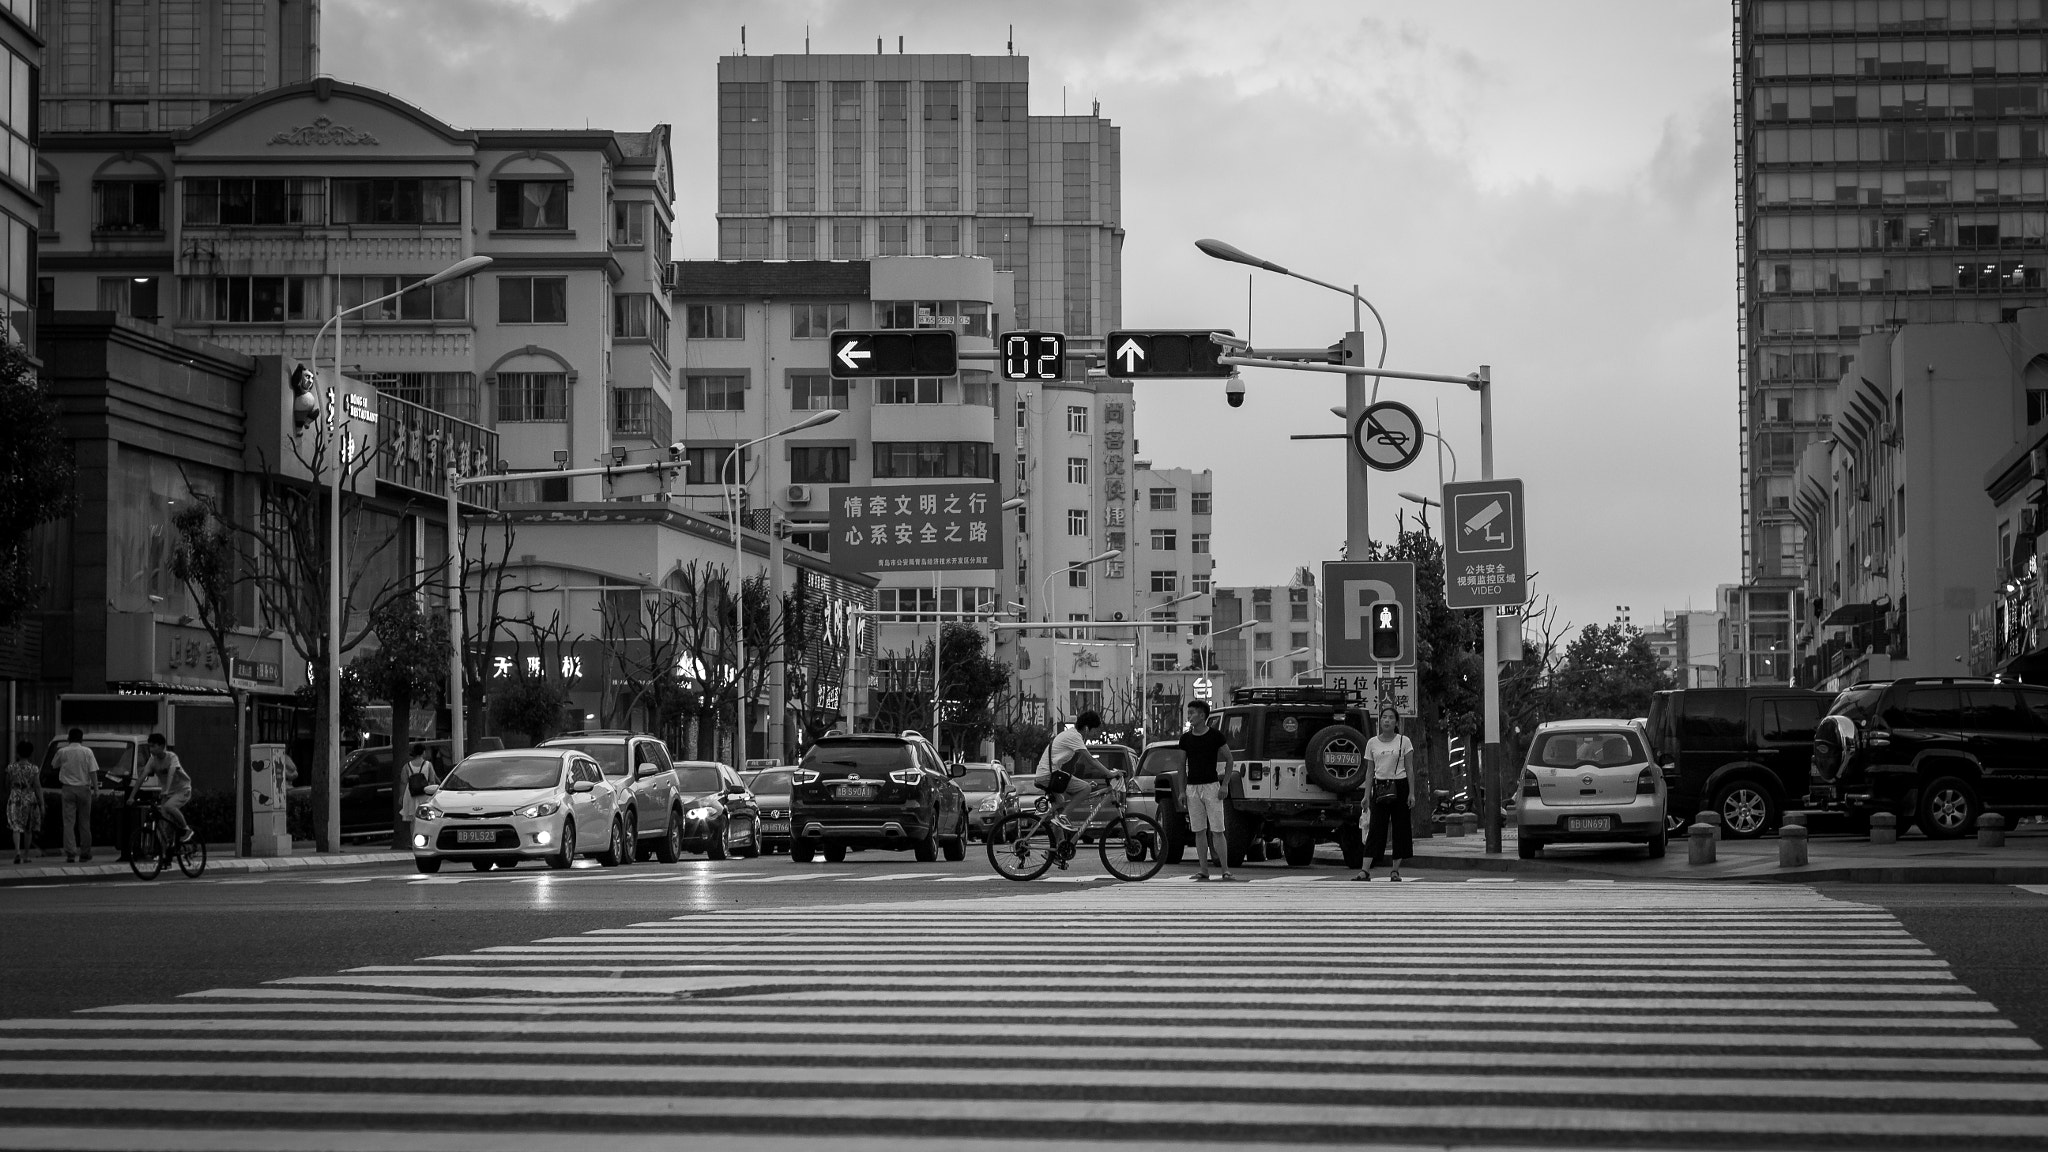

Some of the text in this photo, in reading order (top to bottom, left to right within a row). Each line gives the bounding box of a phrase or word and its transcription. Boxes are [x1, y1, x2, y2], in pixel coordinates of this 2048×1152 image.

[1008, 336, 1058, 378] 02
[844, 492, 987, 518] 情牵文明之行
[845, 521, 988, 546] 心系安全之路
[1465, 563, 1506, 575] 公共安全
[1457, 573, 1516, 587] 视频监控区域
[1471, 585, 1502, 596] VIDEO
